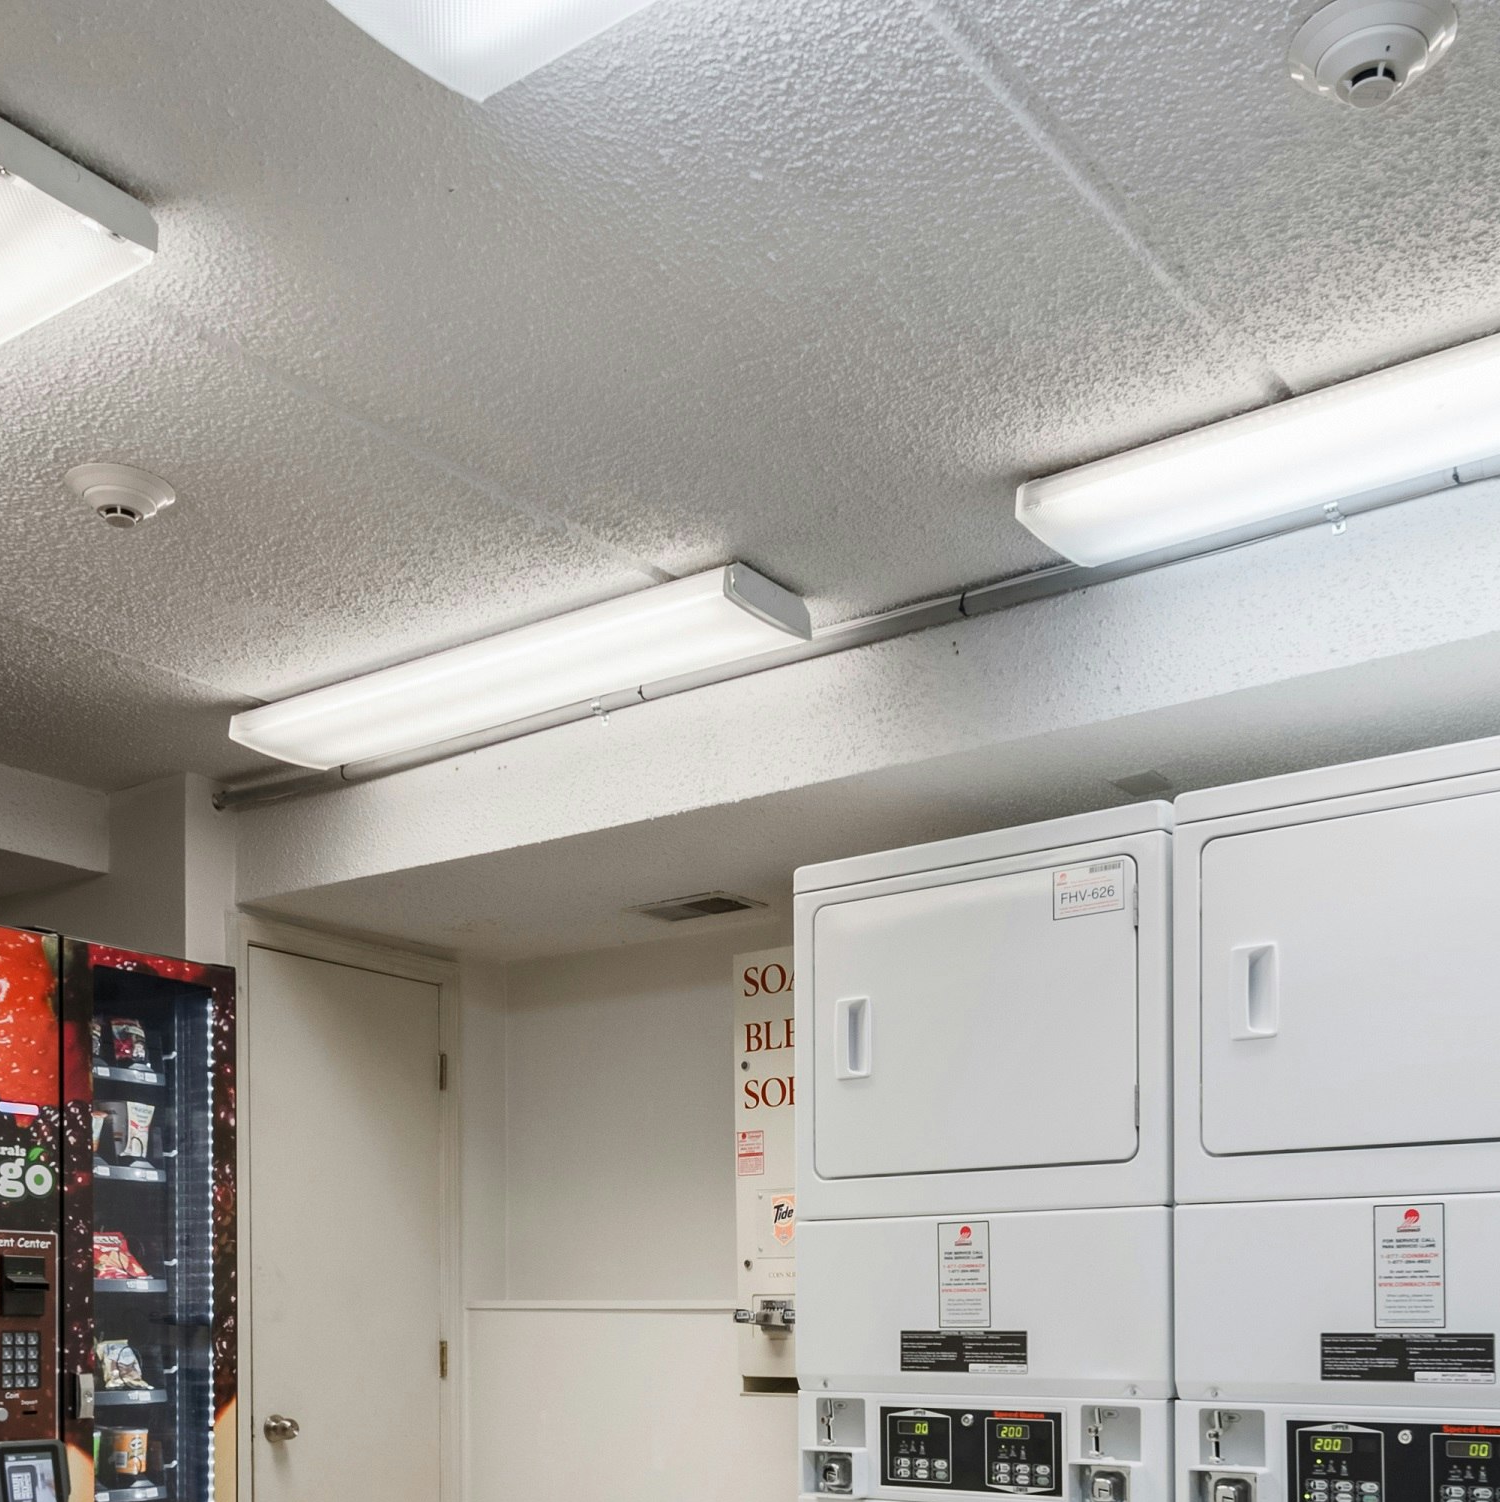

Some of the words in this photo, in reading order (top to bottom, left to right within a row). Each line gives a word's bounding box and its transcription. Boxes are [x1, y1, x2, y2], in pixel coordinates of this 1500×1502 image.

[1060, 885, 1115, 905] FHV-626
[773, 1203, 794, 1224] Tide
[17, 1237, 52, 1249] Center
[915, 1423, 929, 1434] 00
[1000, 1426, 1023, 1438] 200
[1442, 1424, 1476, 1434] Speed
[1314, 1438, 1342, 1451] 200
[1468, 1443, 1489, 1457] 00
